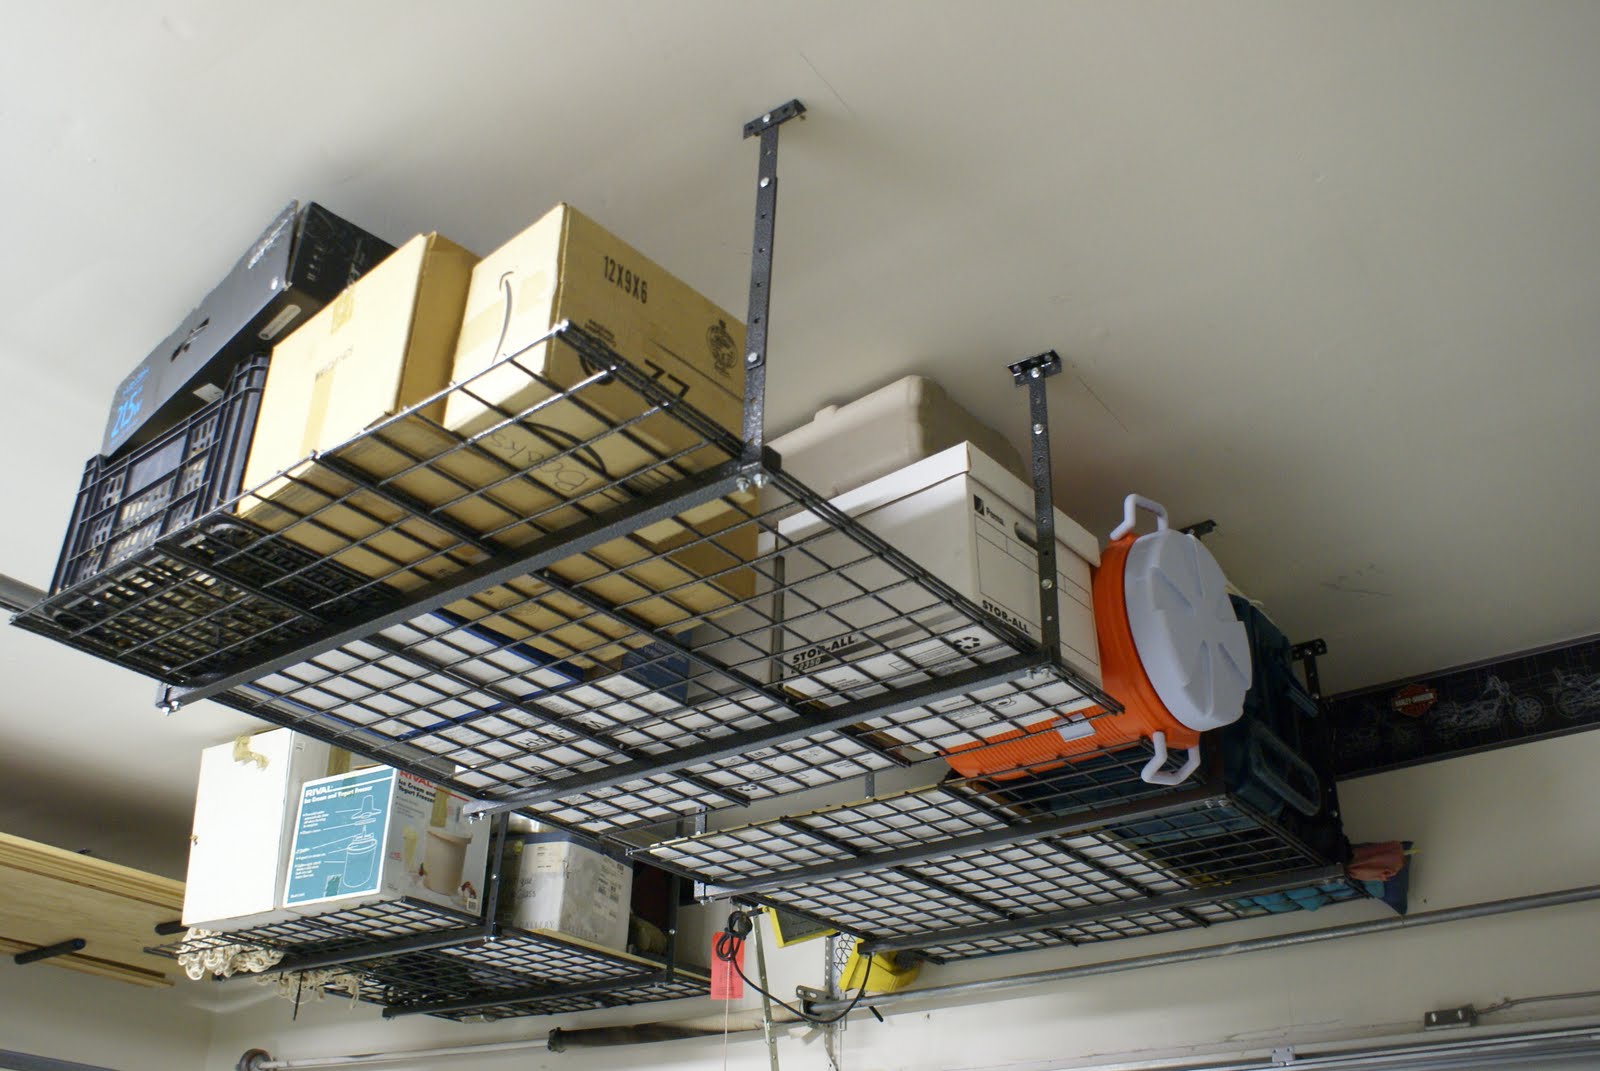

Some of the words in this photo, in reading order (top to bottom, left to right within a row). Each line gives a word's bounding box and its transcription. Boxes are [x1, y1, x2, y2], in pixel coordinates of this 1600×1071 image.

[603, 255, 648, 304] 12X9X6
[982, 599, 1031, 635] STOR-ALL
[792, 635, 855, 664] STOR-ALL
[304, 784, 332, 798] RIVAL
[400, 769, 434, 789] RIVAL
